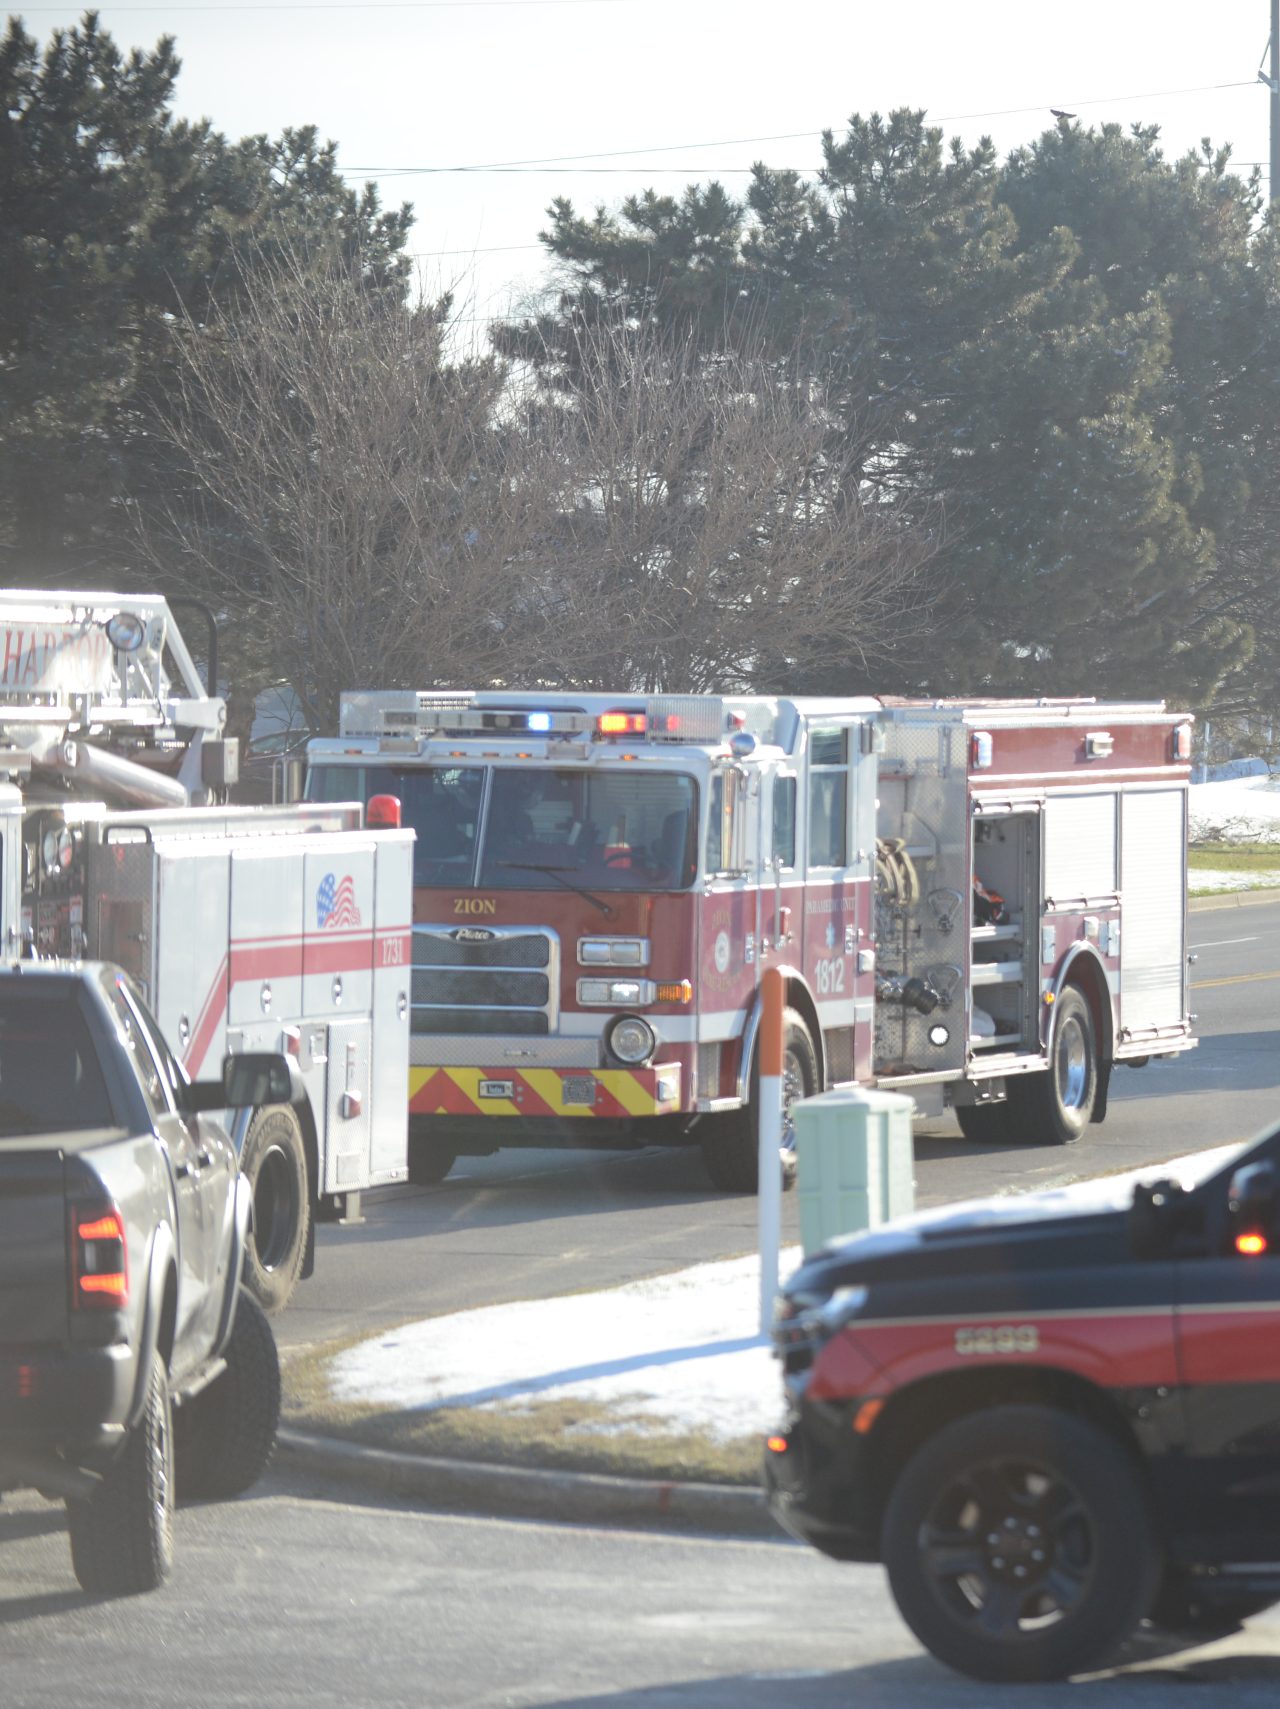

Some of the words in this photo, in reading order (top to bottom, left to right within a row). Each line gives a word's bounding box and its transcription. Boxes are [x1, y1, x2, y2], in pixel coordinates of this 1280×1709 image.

[454, 898, 496, 914] ZION
[382, 938, 403, 965] 1731
[814, 957, 846, 994] 1812
